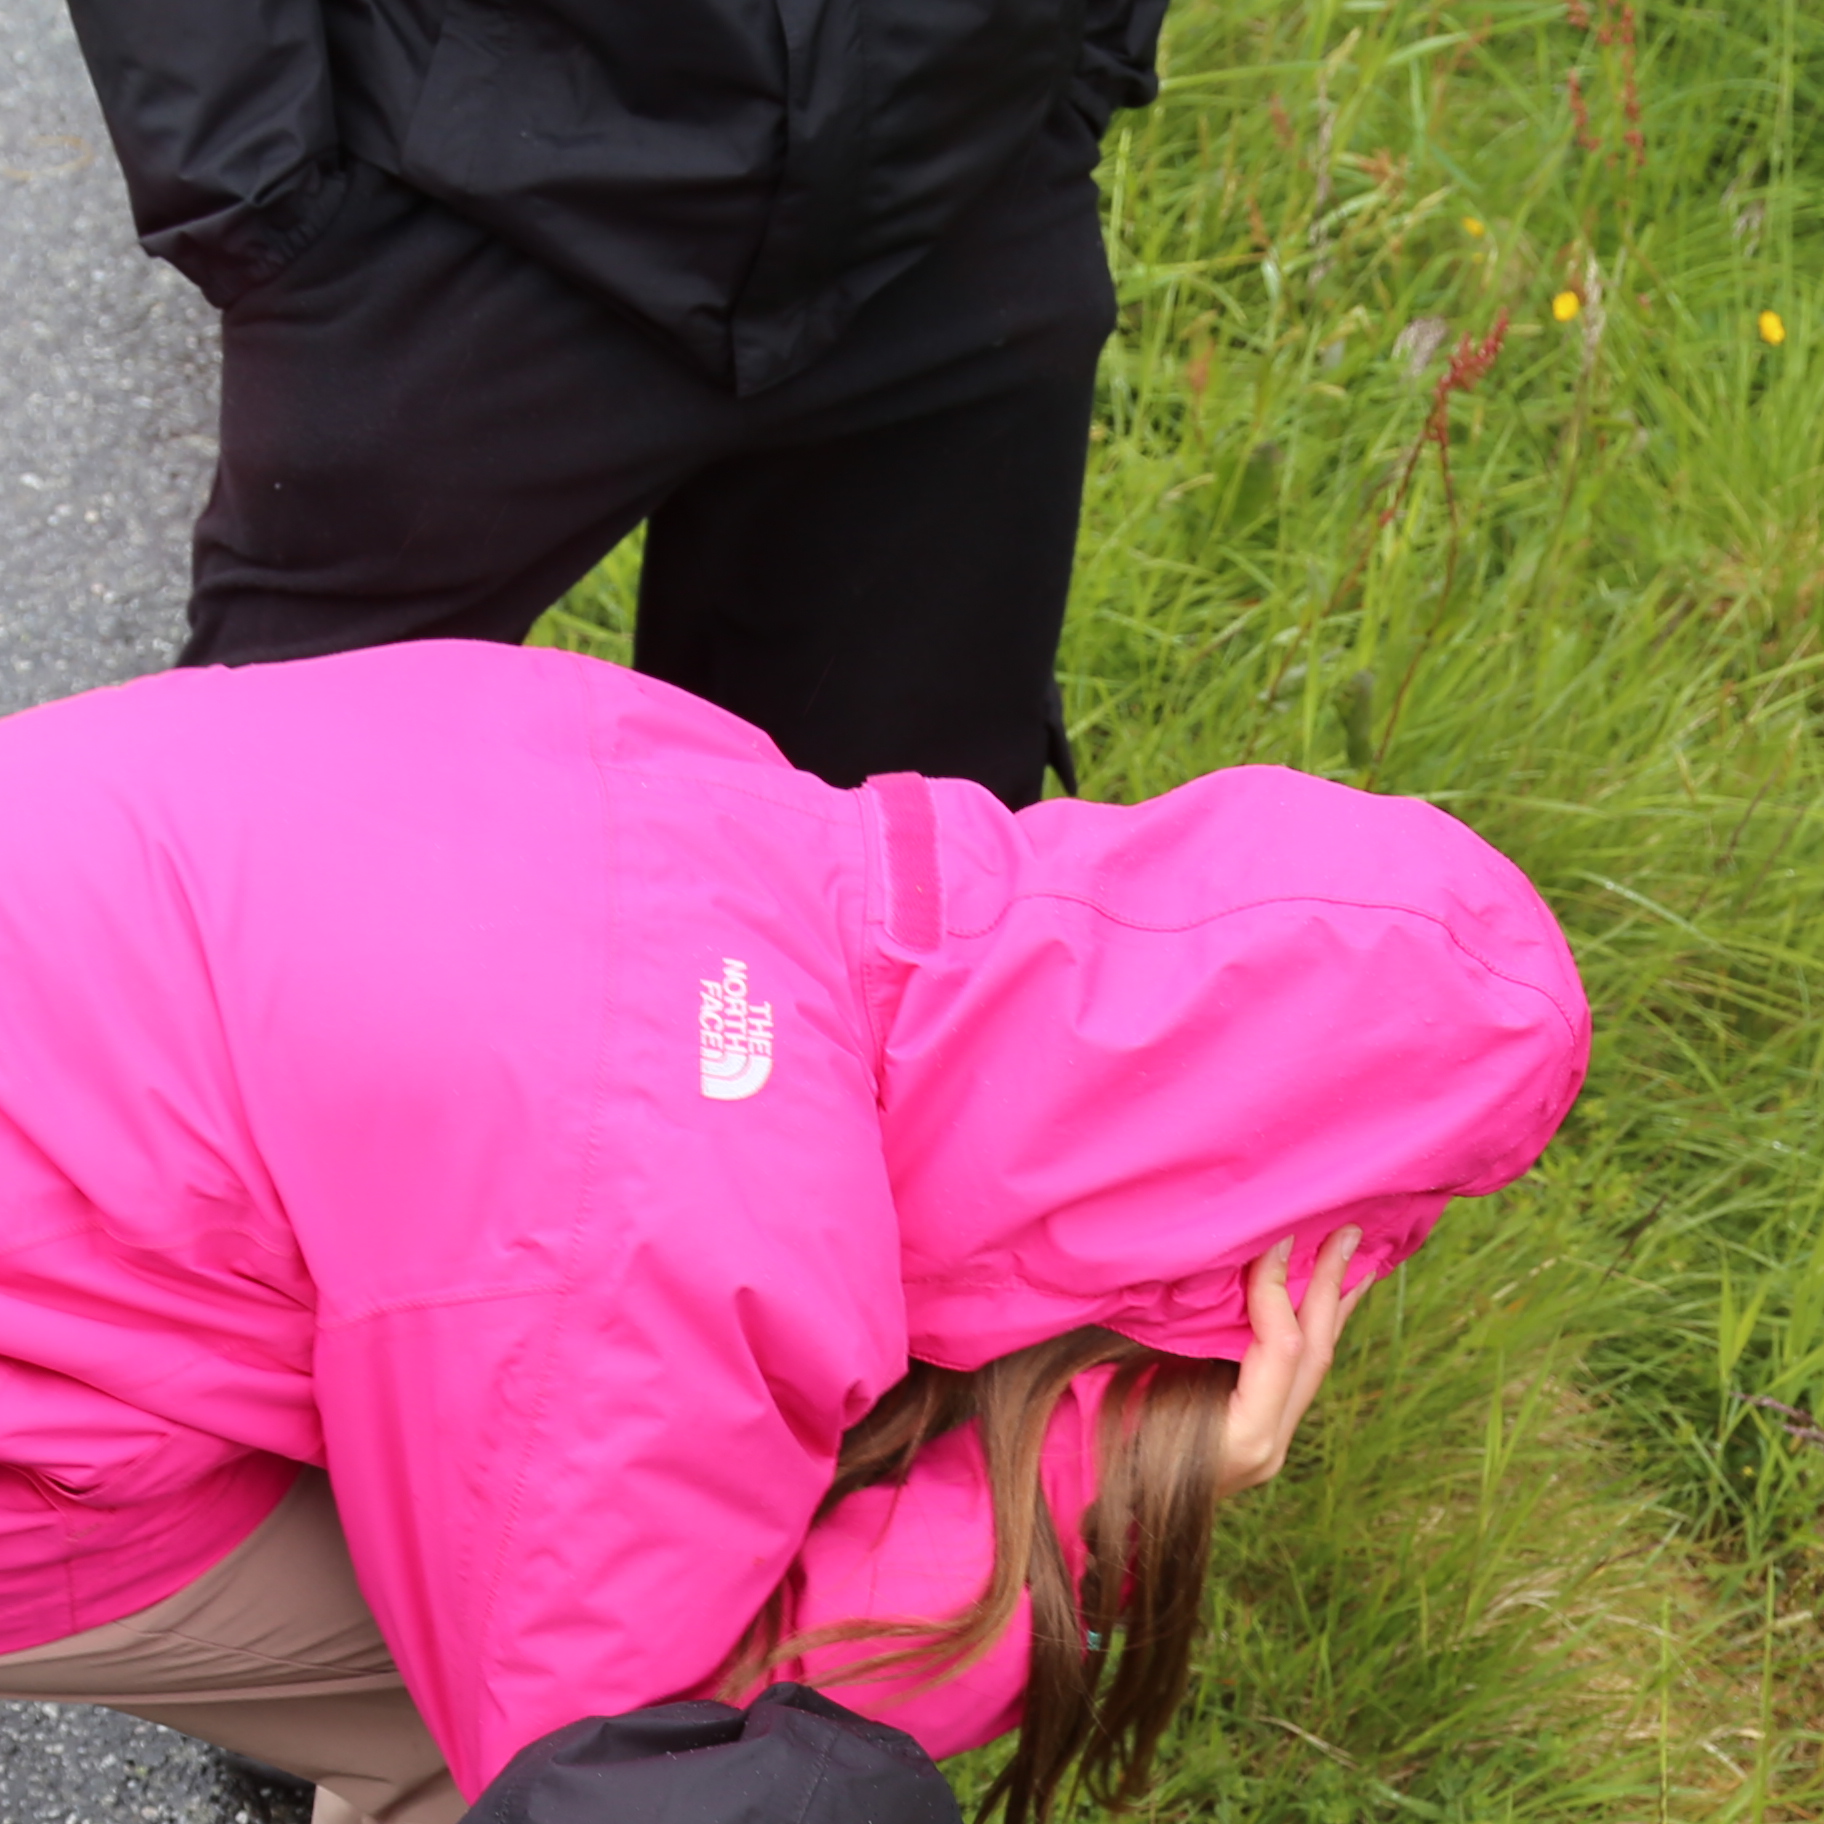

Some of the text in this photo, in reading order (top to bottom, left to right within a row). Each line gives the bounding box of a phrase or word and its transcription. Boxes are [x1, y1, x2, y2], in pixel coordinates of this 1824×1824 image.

[699, 979, 724, 1049] FACE
[723, 958, 748, 1053] NORTH
[749, 1001, 773, 1055] THE
